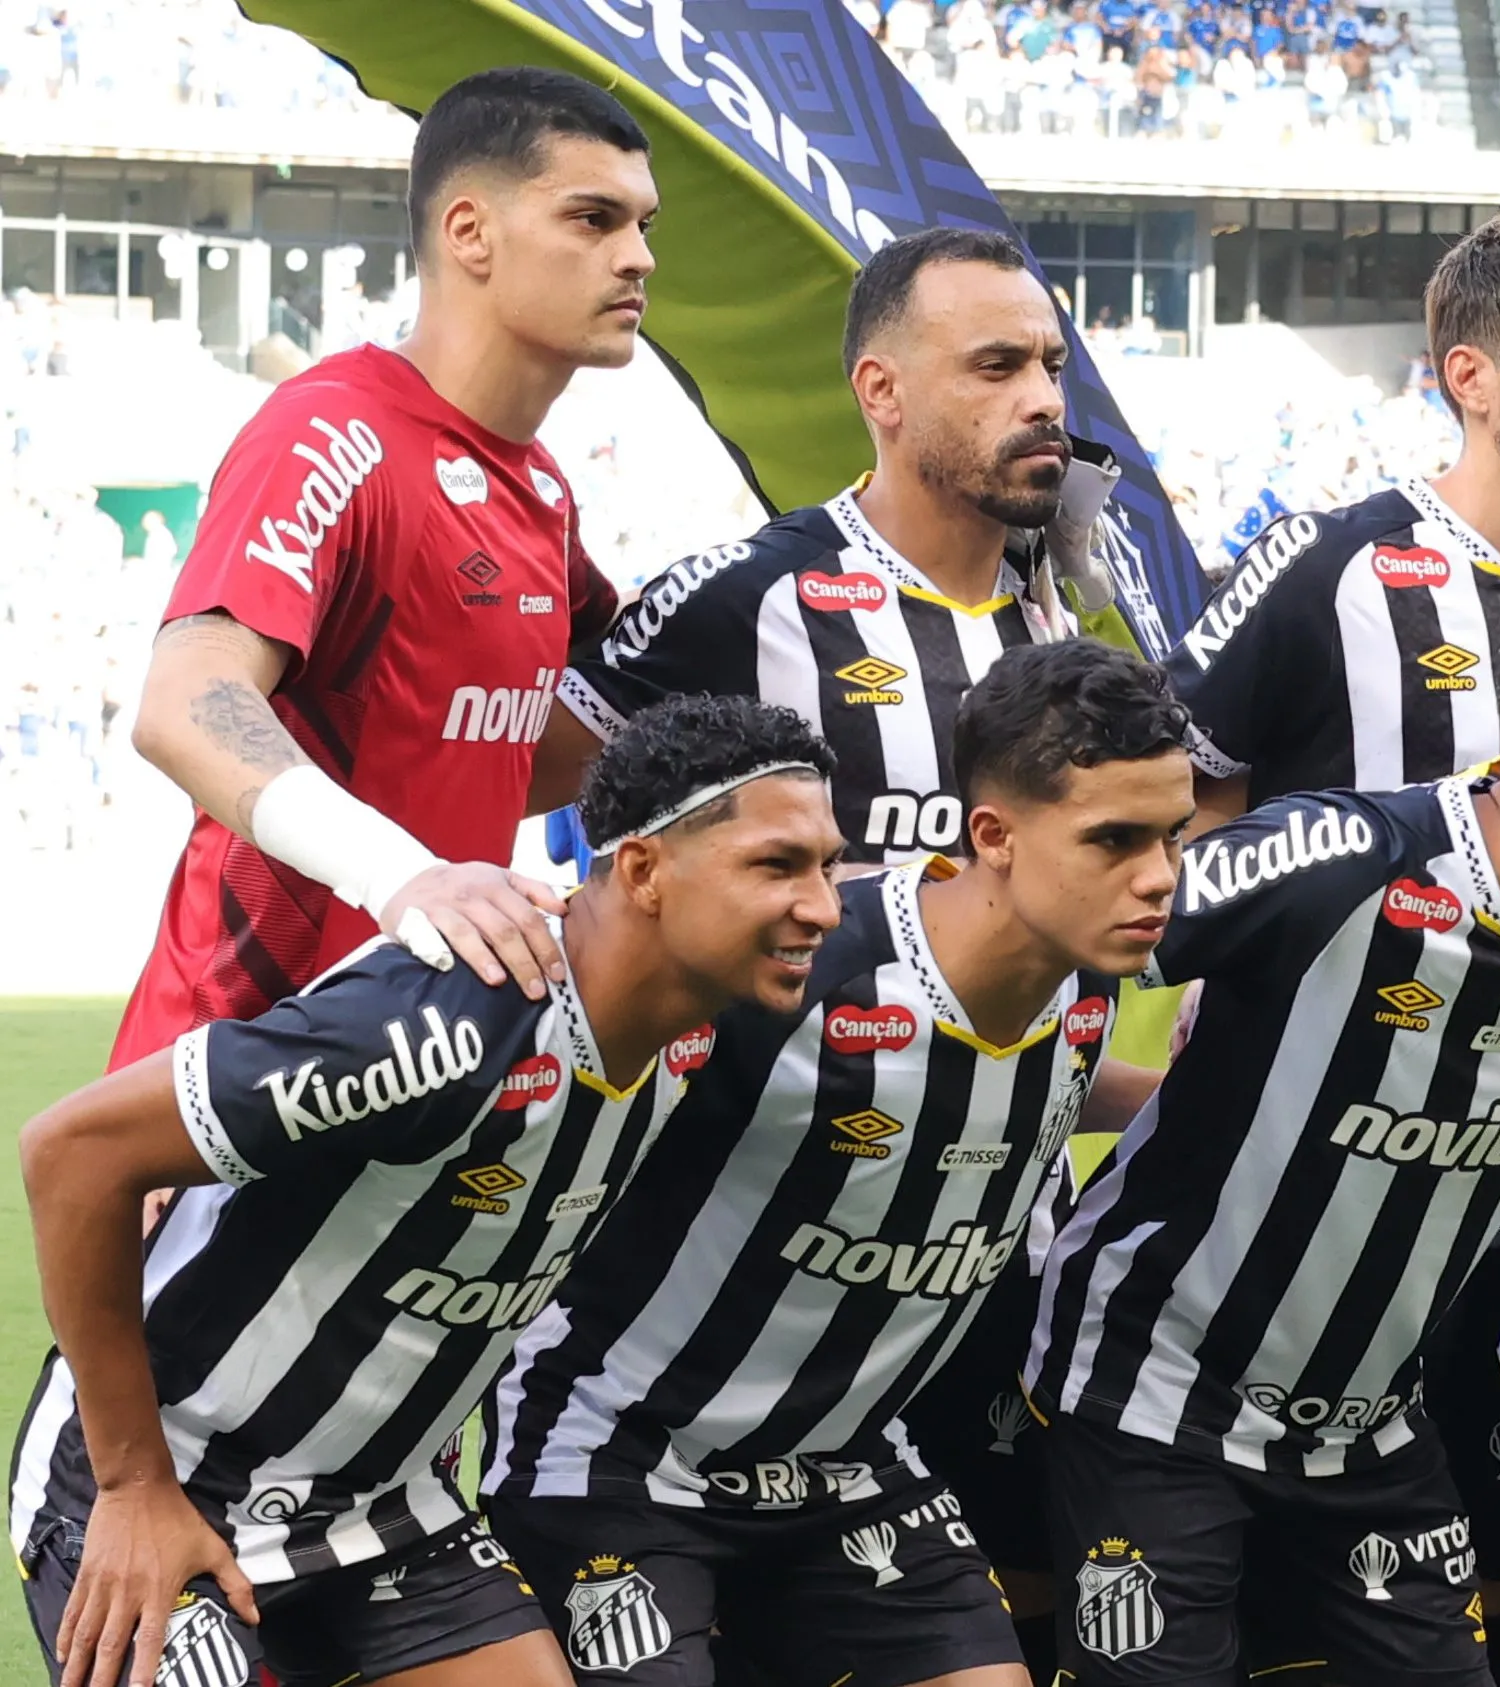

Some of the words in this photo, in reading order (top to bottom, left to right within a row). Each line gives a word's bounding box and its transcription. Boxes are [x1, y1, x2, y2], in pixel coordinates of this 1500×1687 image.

[244, 418, 384, 593] Kicaldo
[1375, 555, 1448, 579] Canção
[803, 578, 883, 602] Canção
[1184, 514, 1318, 671] Kicaldo
[845, 689, 903, 705] umbro
[1425, 675, 1476, 690] umbro
[1182, 806, 1374, 913] Kicaldo
[1388, 886, 1460, 922] Canção
[829, 1015, 914, 1048] Canção
[1375, 1011, 1430, 1031] umbro
[259, 1006, 485, 1142] Kicaldo
[501, 1065, 558, 1096] anção
[830, 1140, 890, 1158] umbro
[451, 1194, 509, 1214] umbro
[1245, 1386, 1400, 1428] CORP
